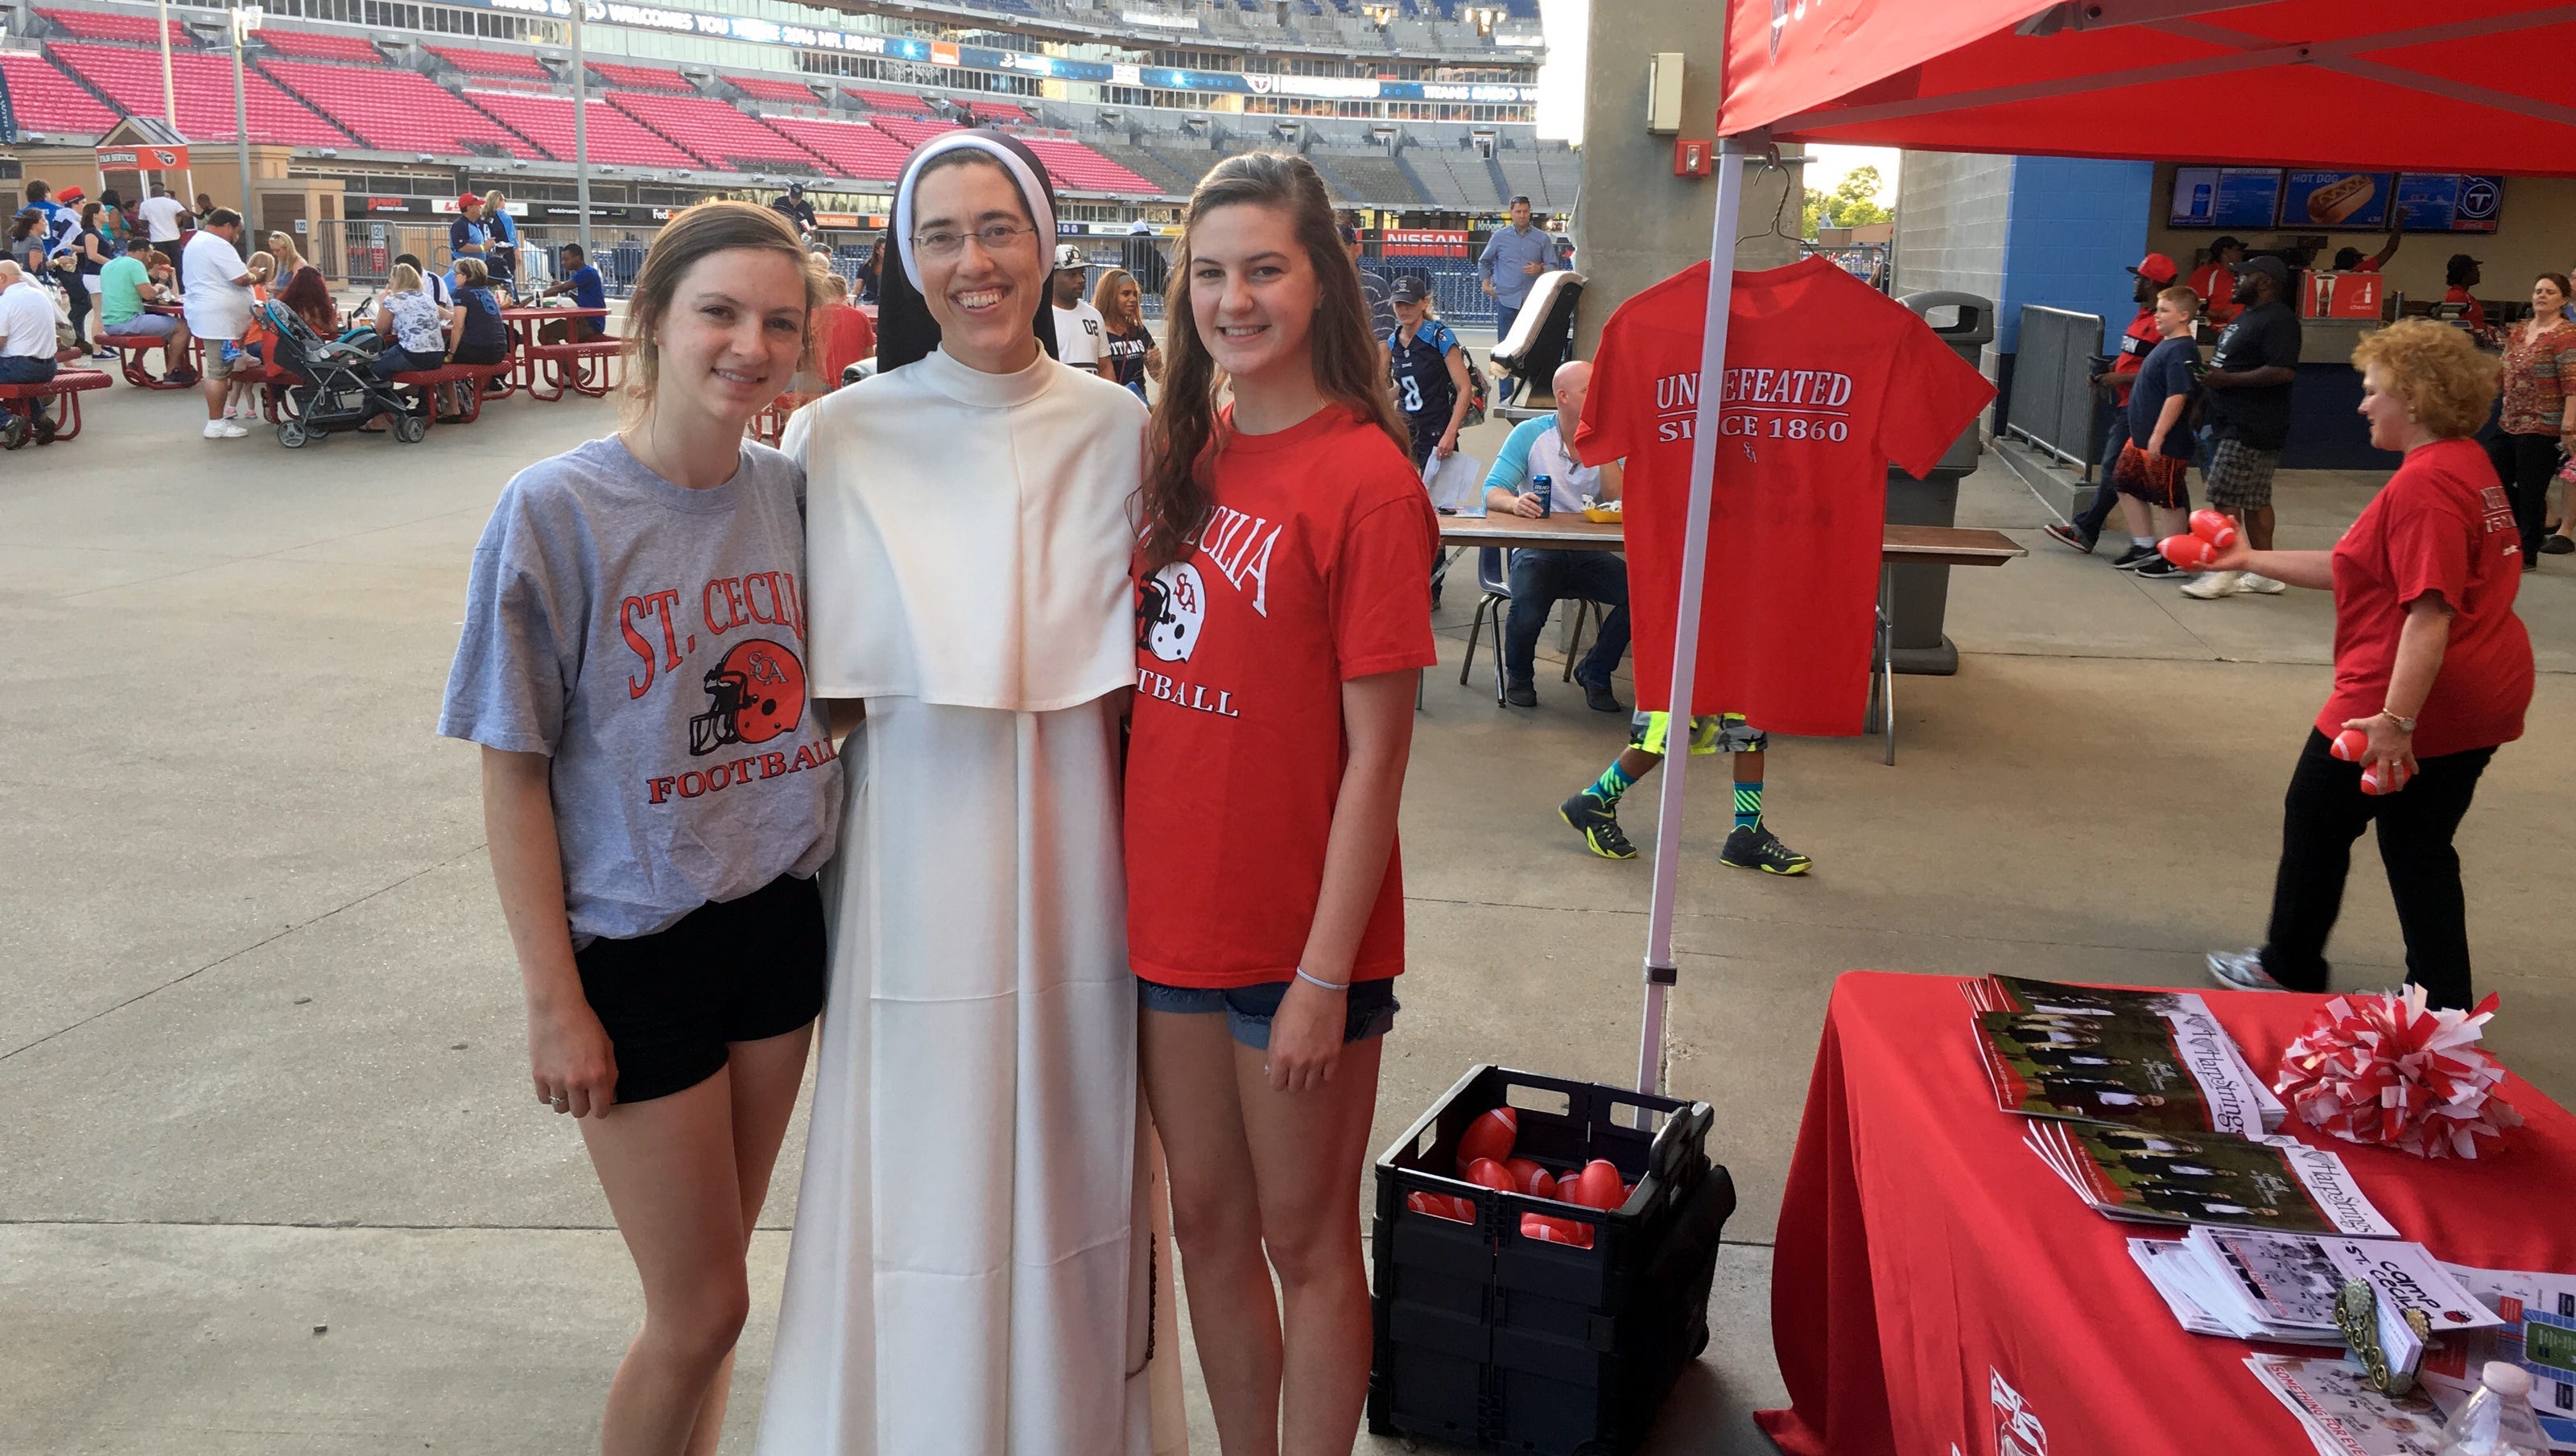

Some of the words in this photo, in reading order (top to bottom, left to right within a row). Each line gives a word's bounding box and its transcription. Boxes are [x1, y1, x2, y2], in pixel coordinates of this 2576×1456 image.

[608, 4, 694, 30] WELCOMES
[696, 15, 729, 35] YOU
[782, 26, 817, 46] 2016
[818, 31, 844, 49] NFL
[844, 35, 886, 54] DRAFT
[1423, 85, 1469, 100] TITANS
[2292, 174, 2316, 183] HOT
[2315, 175, 2339, 184] DOG
[653, 208, 675, 220] FedE
[1387, 233, 1463, 248] NISSAN
[1082, 319, 1099, 336] 02
[1109, 339, 1145, 356] ITANS
[1656, 368, 1852, 410] UNEFEATED
[1658, 415, 1758, 443] SICE
[1768, 417, 1849, 443] 1860
[620, 588, 696, 700] ST.
[703, 571, 807, 641] CECIL
[1136, 666, 1241, 718] TBALL
[646, 736, 839, 804] FOOTBALL
[2271, 1365, 2328, 1417] SOMETHING
[2322, 1416, 2347, 1440] FOR
